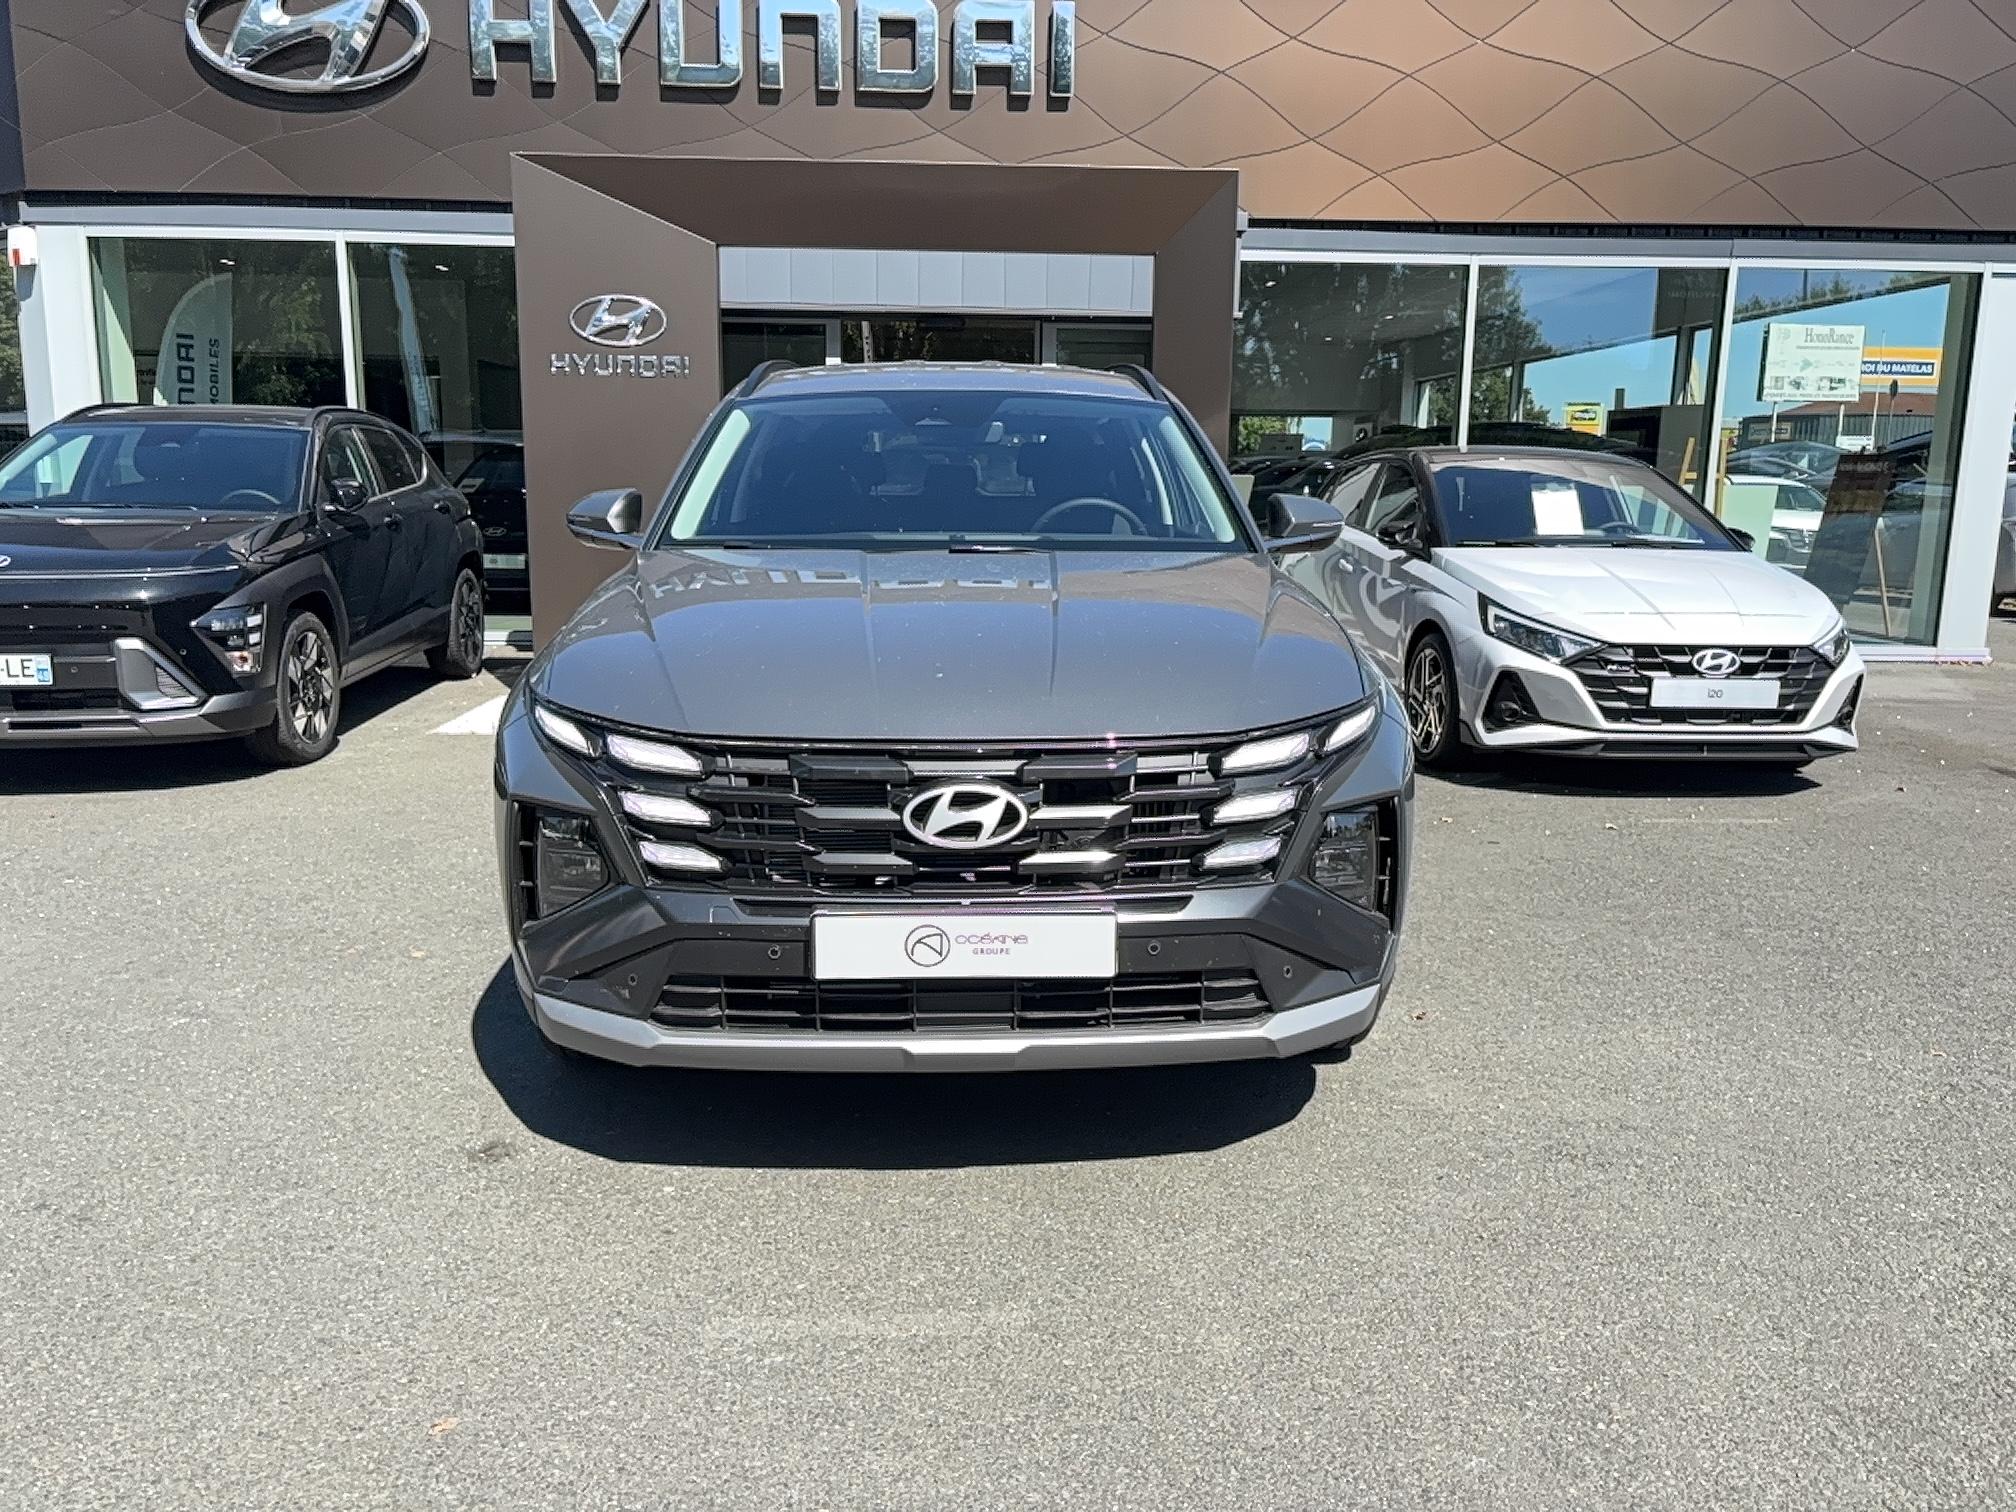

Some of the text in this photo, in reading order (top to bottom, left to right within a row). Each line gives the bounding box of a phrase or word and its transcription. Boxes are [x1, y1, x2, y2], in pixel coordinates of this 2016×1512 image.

[469, 0, 1075, 98] HYUNDAI
[550, 353, 689, 378] HYUNDAI
[1892, 364, 1933, 374] MATELAS
